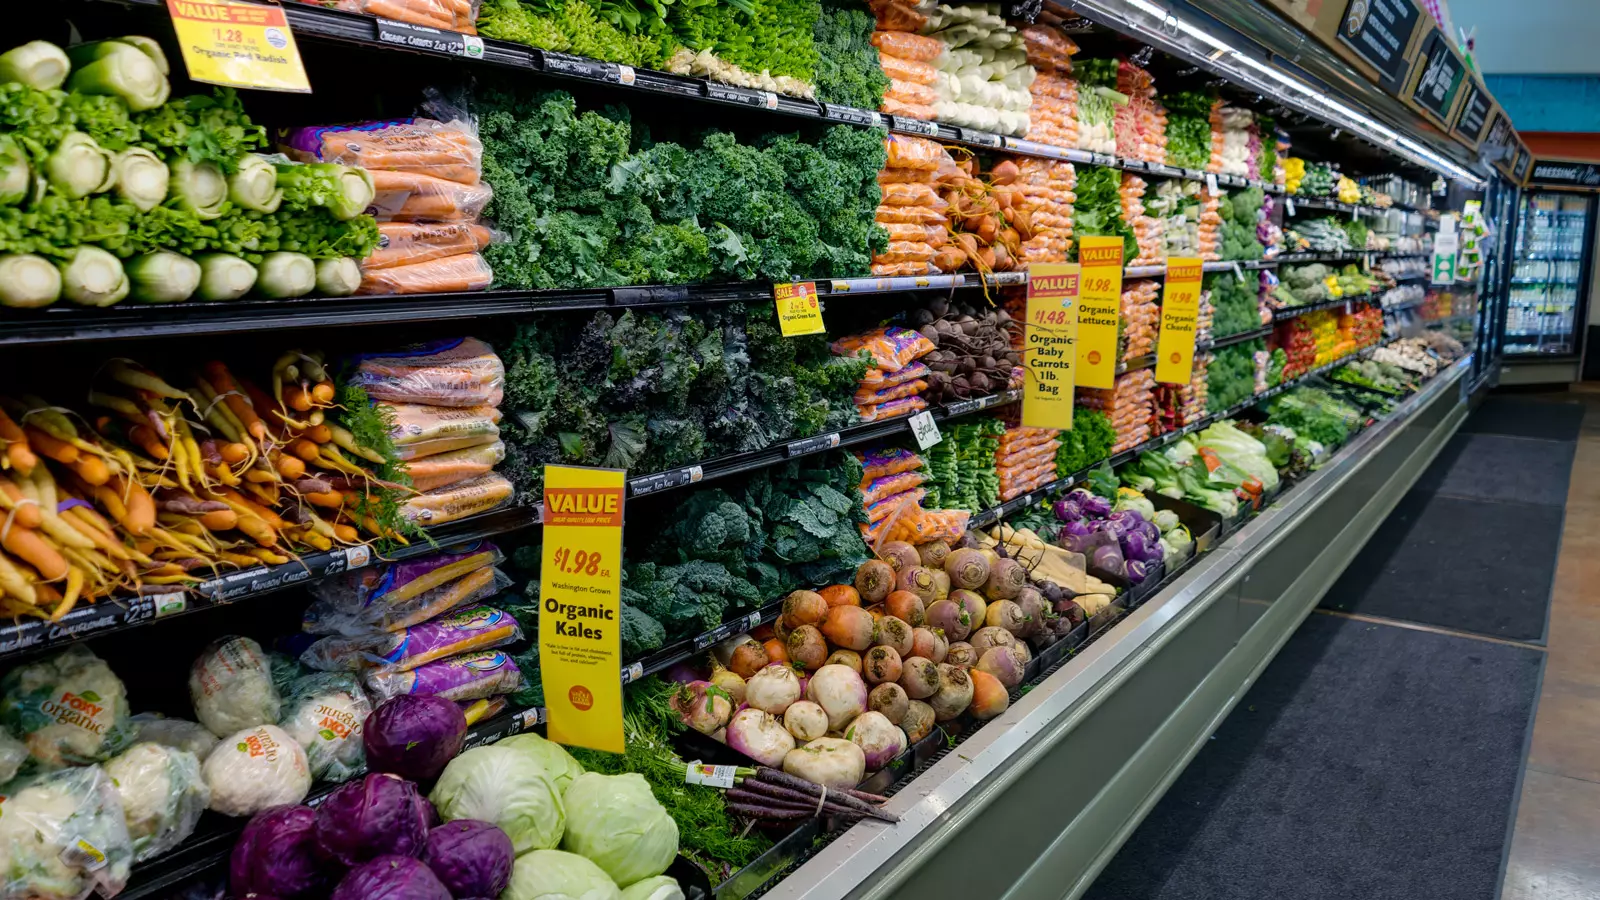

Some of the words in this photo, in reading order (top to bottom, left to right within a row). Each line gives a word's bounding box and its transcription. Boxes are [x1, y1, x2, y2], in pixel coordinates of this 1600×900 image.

[175, 1, 231, 20] VALUE
[192, 45, 231, 58] Organic
[256, 53, 287, 64] Radish
[1534, 166, 1576, 179] DRESSING
[1081, 249, 1120, 260] VALUE
[1168, 268, 1200, 278] VALUE
[1032, 278, 1076, 290] VALUE
[776, 287, 793, 299] SALE
[1035, 309, 1066, 324] $1.48
[1079, 304, 1115, 316] Organic
[1077, 316, 1116, 326] Lettuces
[1165, 314, 1195, 323] Organic
[1166, 323, 1192, 332] Chards
[1030, 334, 1072, 346] Organic
[1038, 347, 1064, 358] Baby
[1031, 358, 1069, 369] Carrots
[1039, 383, 1059, 395] Bag
[548, 493, 618, 513] VALUE
[553, 546, 602, 576] $1.98
[552, 581, 587, 593] Washington
[589, 586, 611, 595] Grown
[545, 598, 613, 620] Organic
[0, 634, 43, 652] RGANIC
[49, 615, 117, 639] CAULIFLOWER
[555, 620, 602, 640] Kales
[61, 692, 103, 717] FOXY
[40, 700, 105, 735] Organic
[314, 704, 362, 735] Organic
[319, 716, 353, 740] FOXY
